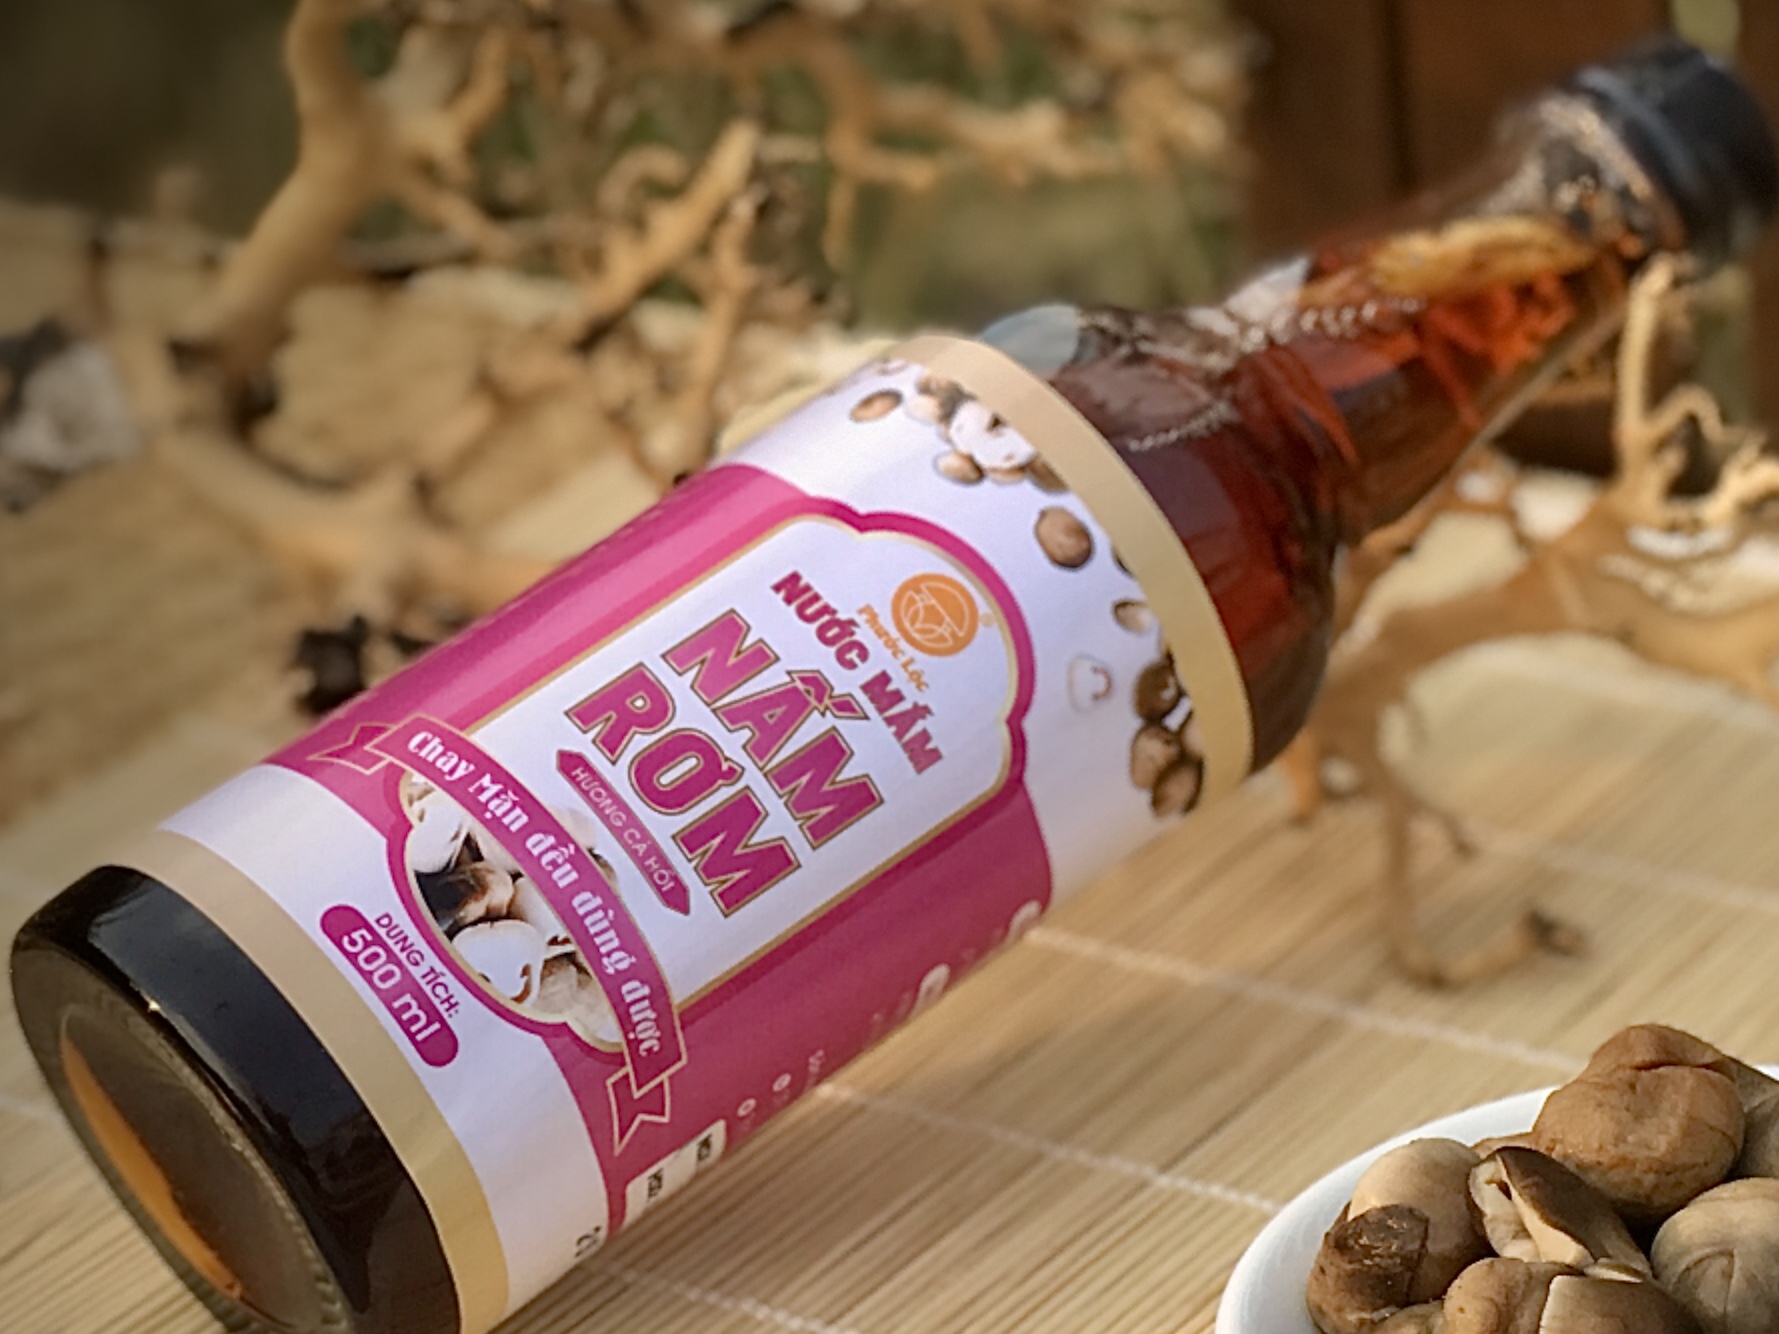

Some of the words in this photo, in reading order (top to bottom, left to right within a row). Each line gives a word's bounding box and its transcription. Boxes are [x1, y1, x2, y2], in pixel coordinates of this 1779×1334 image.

[660, 608, 885, 850] NẤM
[769, 569, 870, 671] NƯỚC
[859, 669, 944, 776] MẮM
[564, 661, 802, 918] RƠM
[571, 766, 627, 827] HƯƠNG
[341, 928, 402, 990] 500
[391, 993, 442, 1042] ml
[375, 911, 425, 967] DUNG
[420, 965, 460, 1019] TÍCH:
[406, 730, 475, 782] Chay
[466, 773, 530, 832] Mặn
[525, 832, 580, 889] đều
[570, 890, 637, 975] dùng
[620, 979, 662, 1057] được
